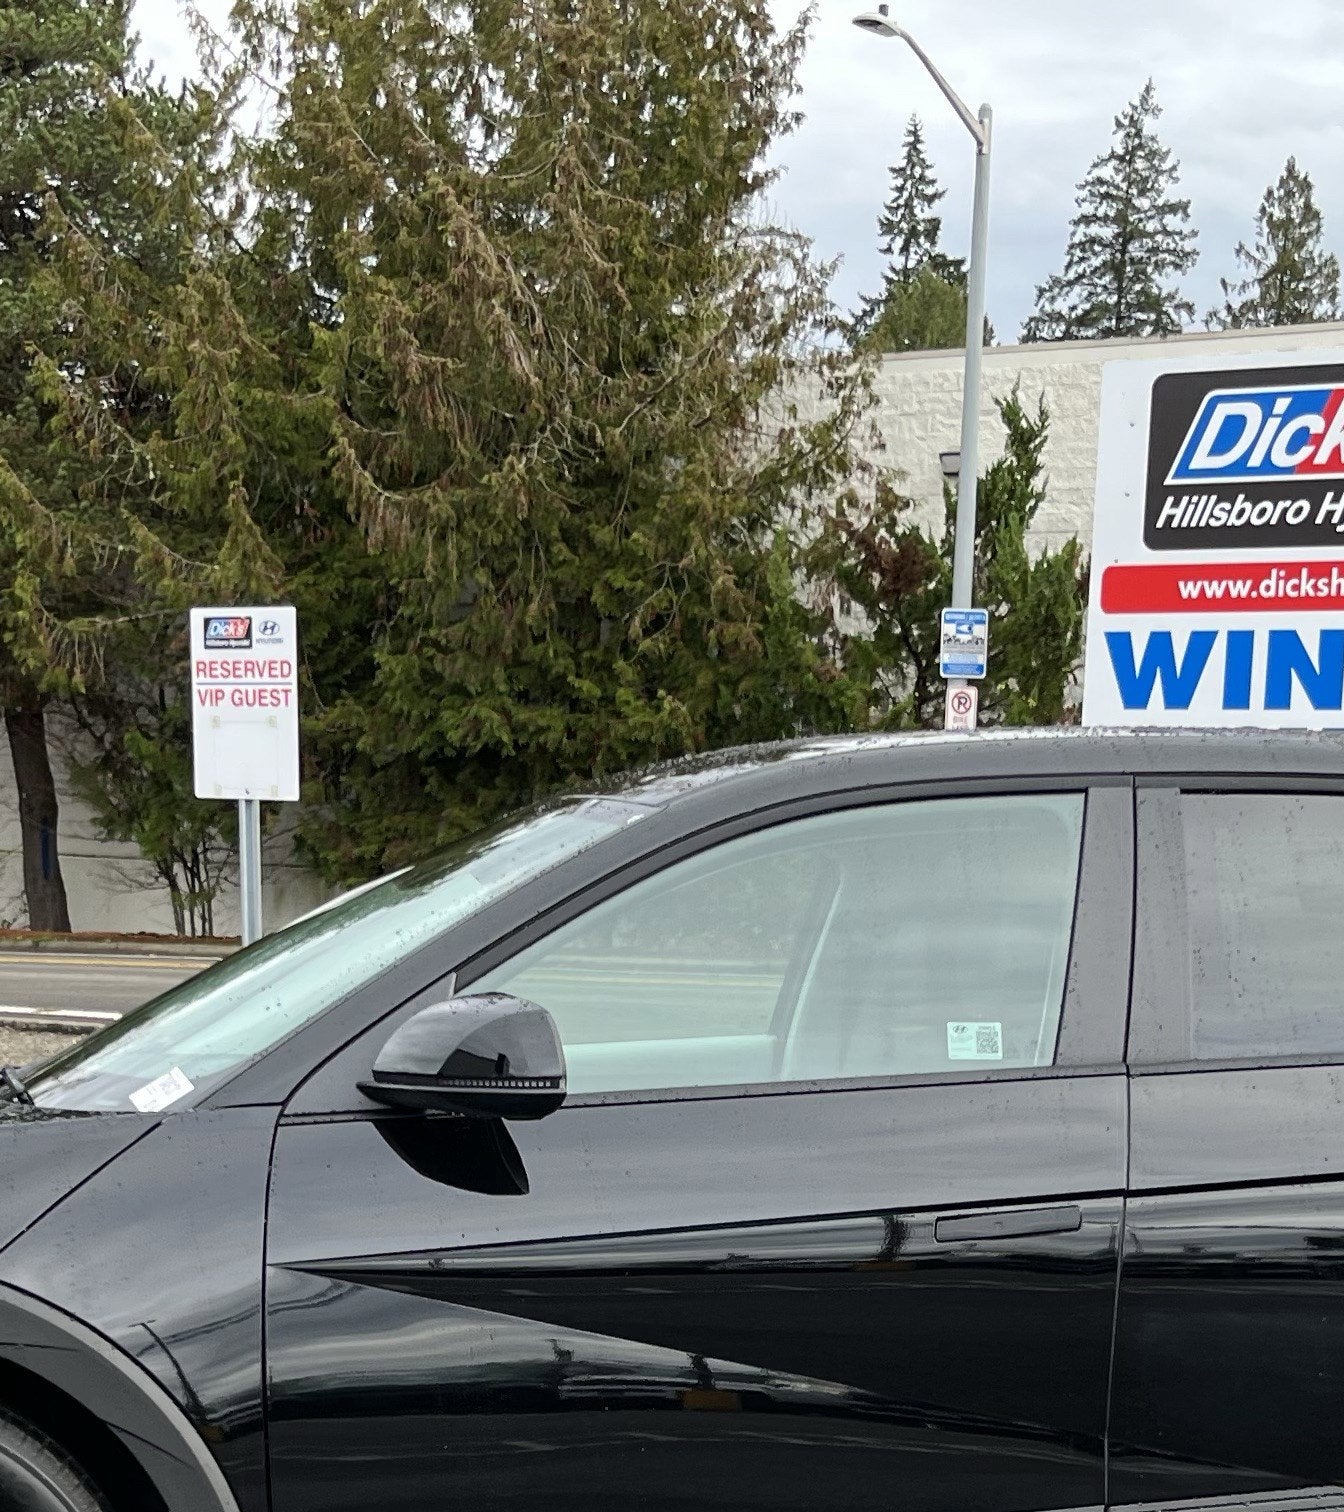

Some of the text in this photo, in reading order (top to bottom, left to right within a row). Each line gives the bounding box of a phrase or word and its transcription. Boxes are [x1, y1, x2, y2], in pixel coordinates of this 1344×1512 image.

[1155, 493, 1311, 529] Hillsboro
[195, 660, 292, 679] RESERVED
[197, 688, 292, 707] VIP GUEST
